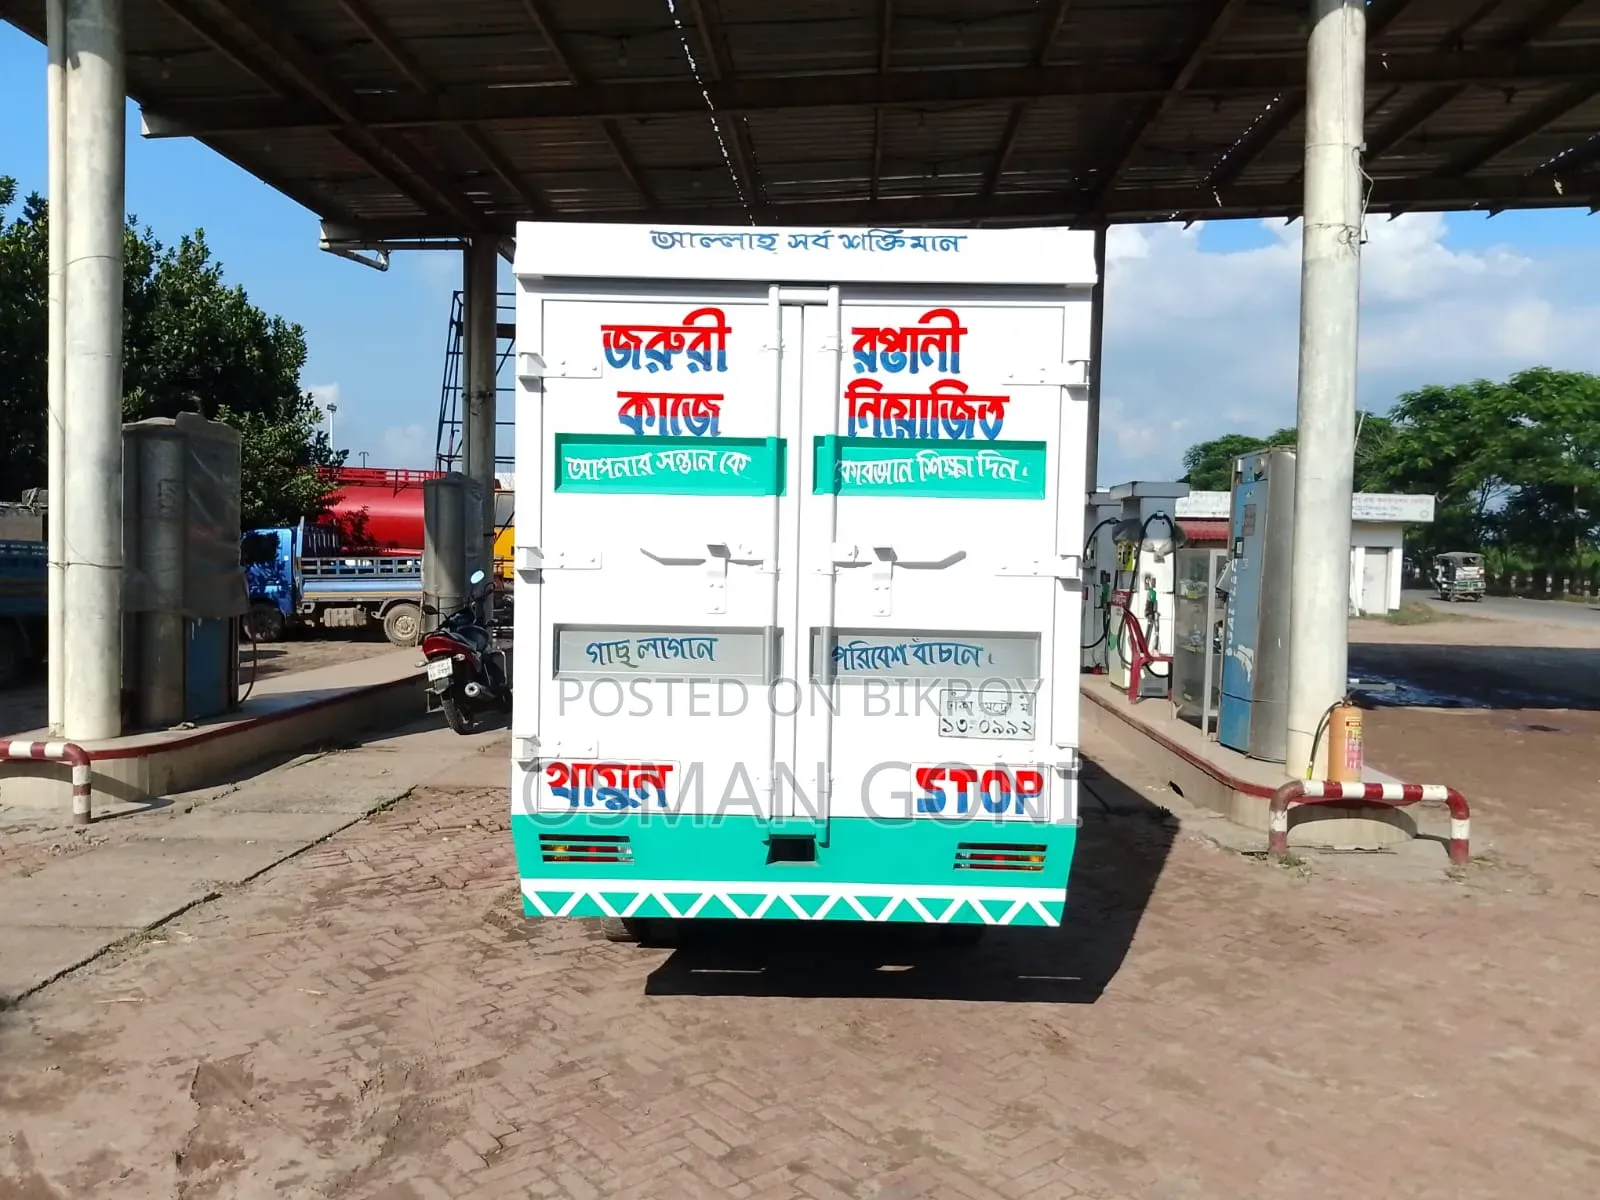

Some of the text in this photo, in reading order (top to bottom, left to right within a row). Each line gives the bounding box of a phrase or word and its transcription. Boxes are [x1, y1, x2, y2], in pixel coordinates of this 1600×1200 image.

[788, 230, 833, 250] সর্ব
[601, 307, 968, 374] জরুরী রপ্তানী
[617, 378, 1010, 440] কাজে নিয়োজিত
[565, 453, 654, 480] আপনার
[656, 449, 717, 474] সন্তান
[720, 451, 751, 475] কে
[916, 449, 975, 482] শিক্ষা
[586, 639, 638, 668] গাছ
[636, 637, 718, 661] লাগান
[832, 640, 909, 670] পরিবেশ
[546, 762, 673, 810] থামুন
[915, 767, 1043, 814] STOP
